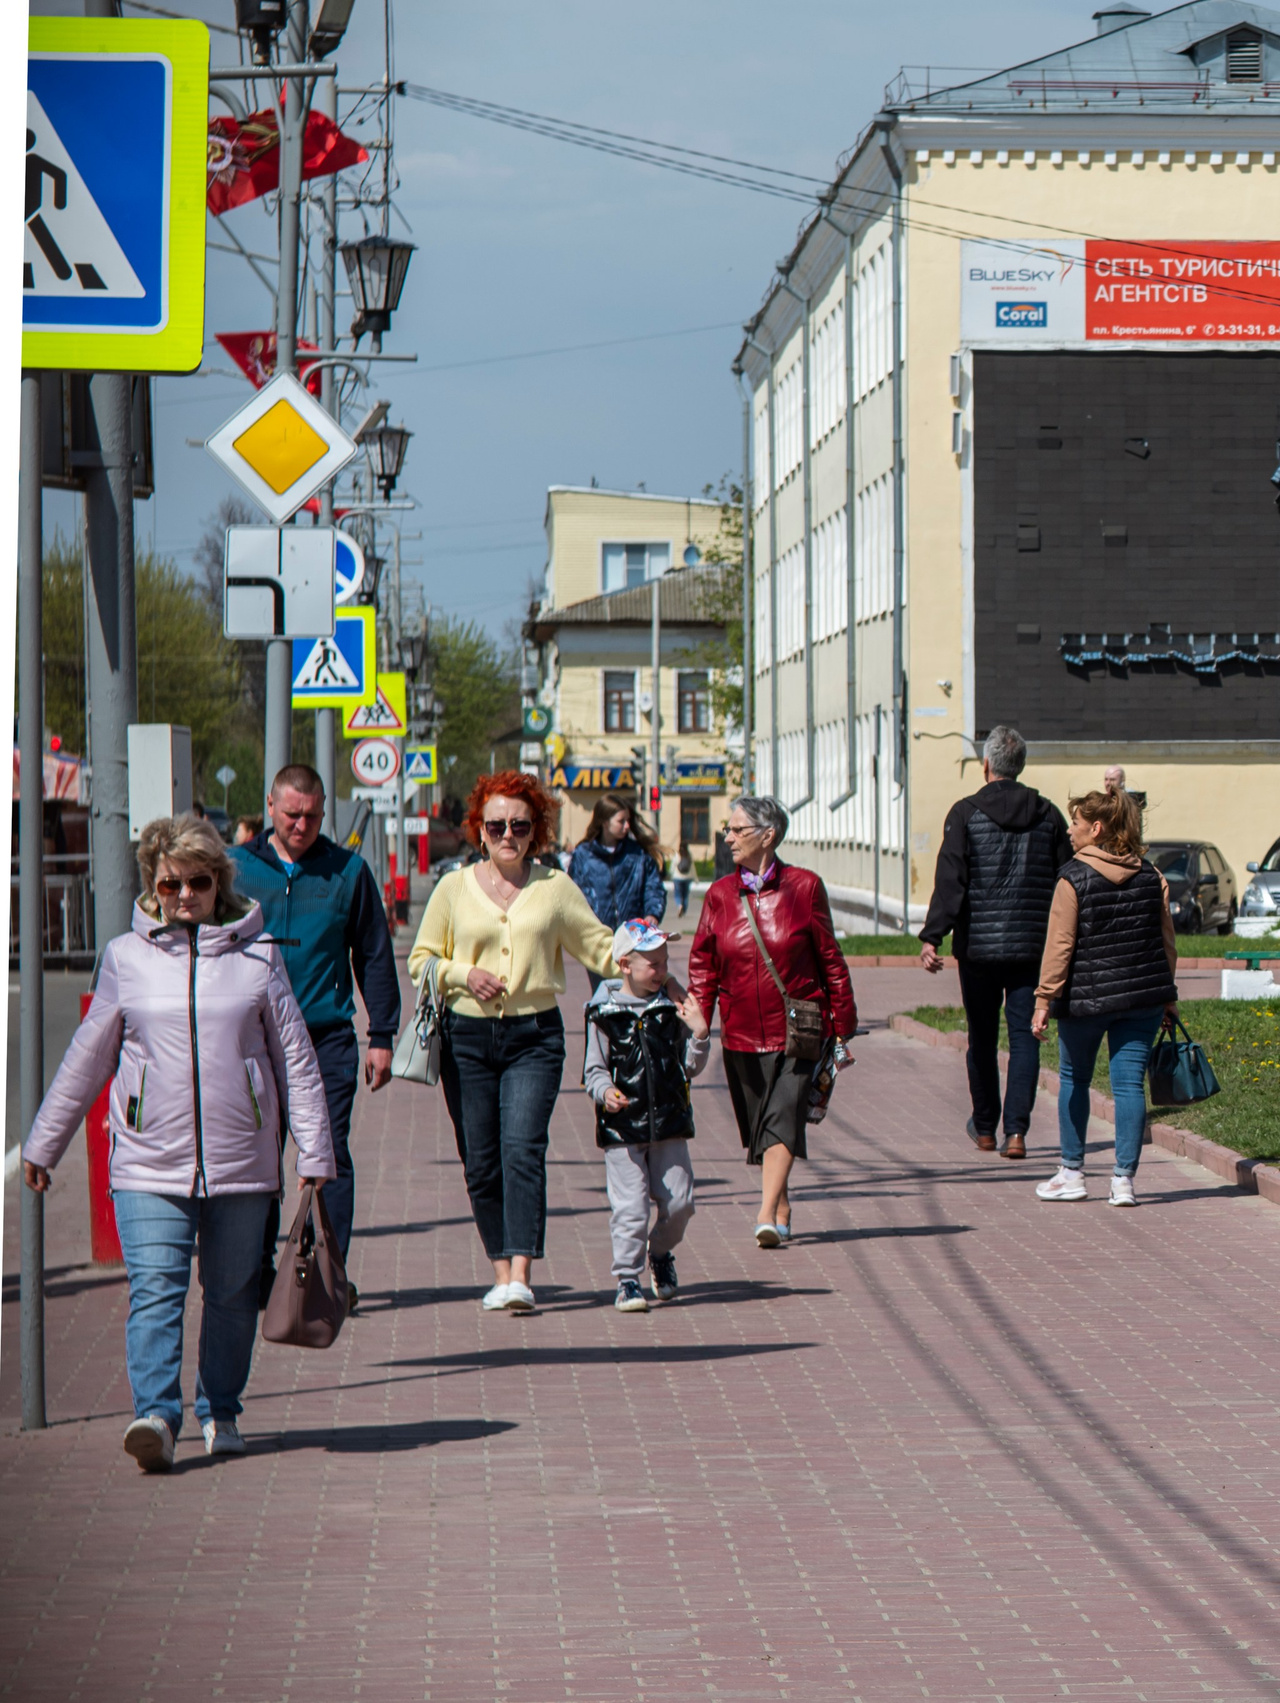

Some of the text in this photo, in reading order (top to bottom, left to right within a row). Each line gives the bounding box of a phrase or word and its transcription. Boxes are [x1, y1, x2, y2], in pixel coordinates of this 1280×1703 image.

[1094, 258, 1153, 278] СЕТЬ
[1094, 284, 1208, 303] АГЕНТСТВ
[998, 306, 1044, 321] Coral
[1093, 326, 1110, 335] пл.
[1112, 325, 1184, 337] Крестьянина,
[1217, 325, 1265, 337] 3-31-31,
[362, 751, 389, 771] 40
